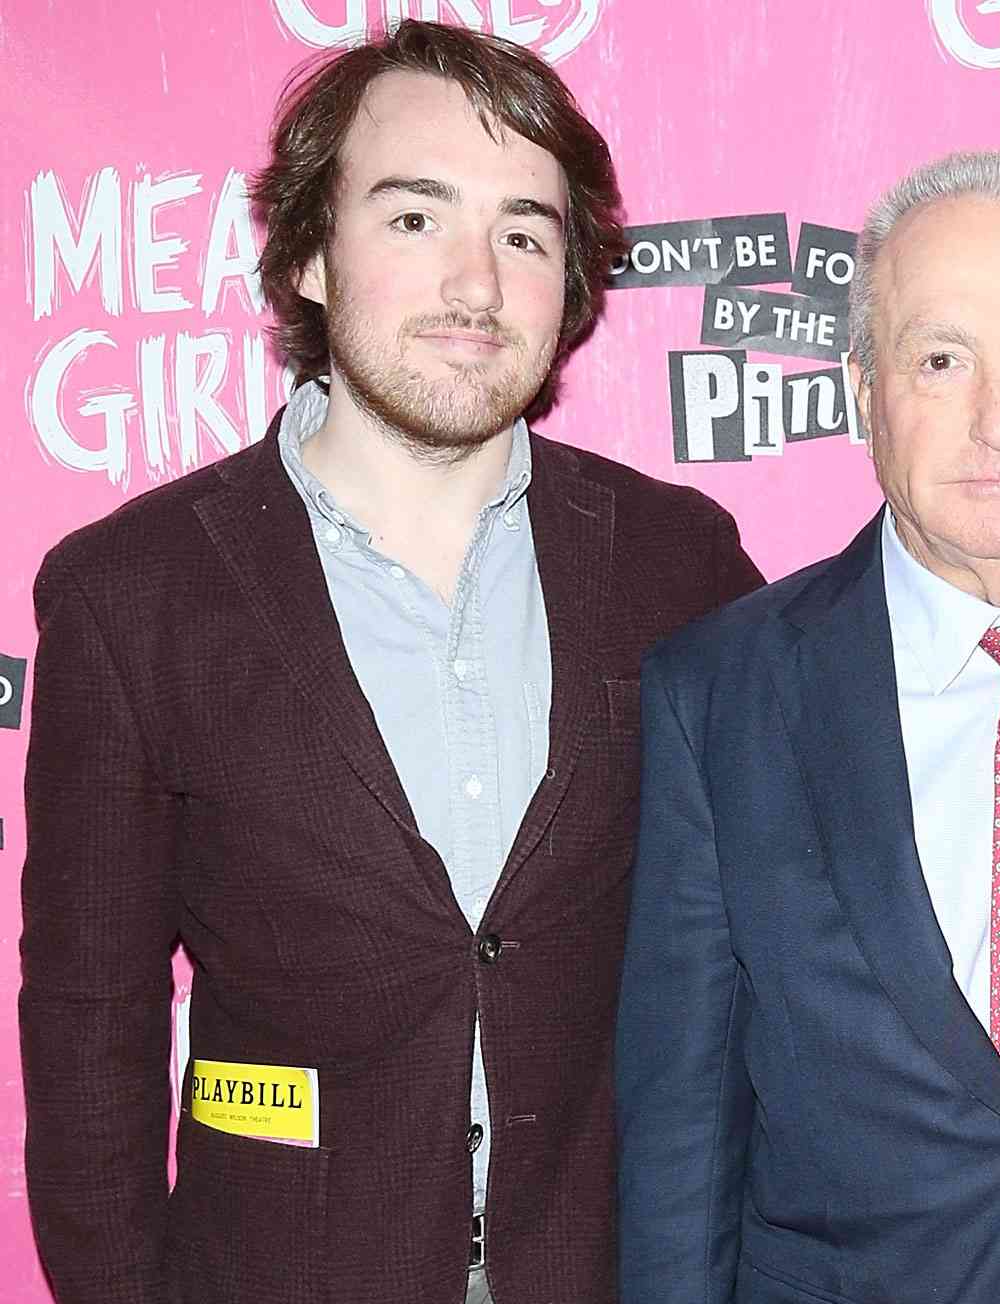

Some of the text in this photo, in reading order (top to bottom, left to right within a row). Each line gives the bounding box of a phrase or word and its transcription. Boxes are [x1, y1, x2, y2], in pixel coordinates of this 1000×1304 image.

[24, 162, 273, 321] MEA
[734, 234, 777, 268] BE
[713, 298, 837, 347] BY THE
[25, 327, 296, 492] GIRL
[682, 353, 864, 462] Pin
[192, 1076, 302, 1109] PLAYBILL
